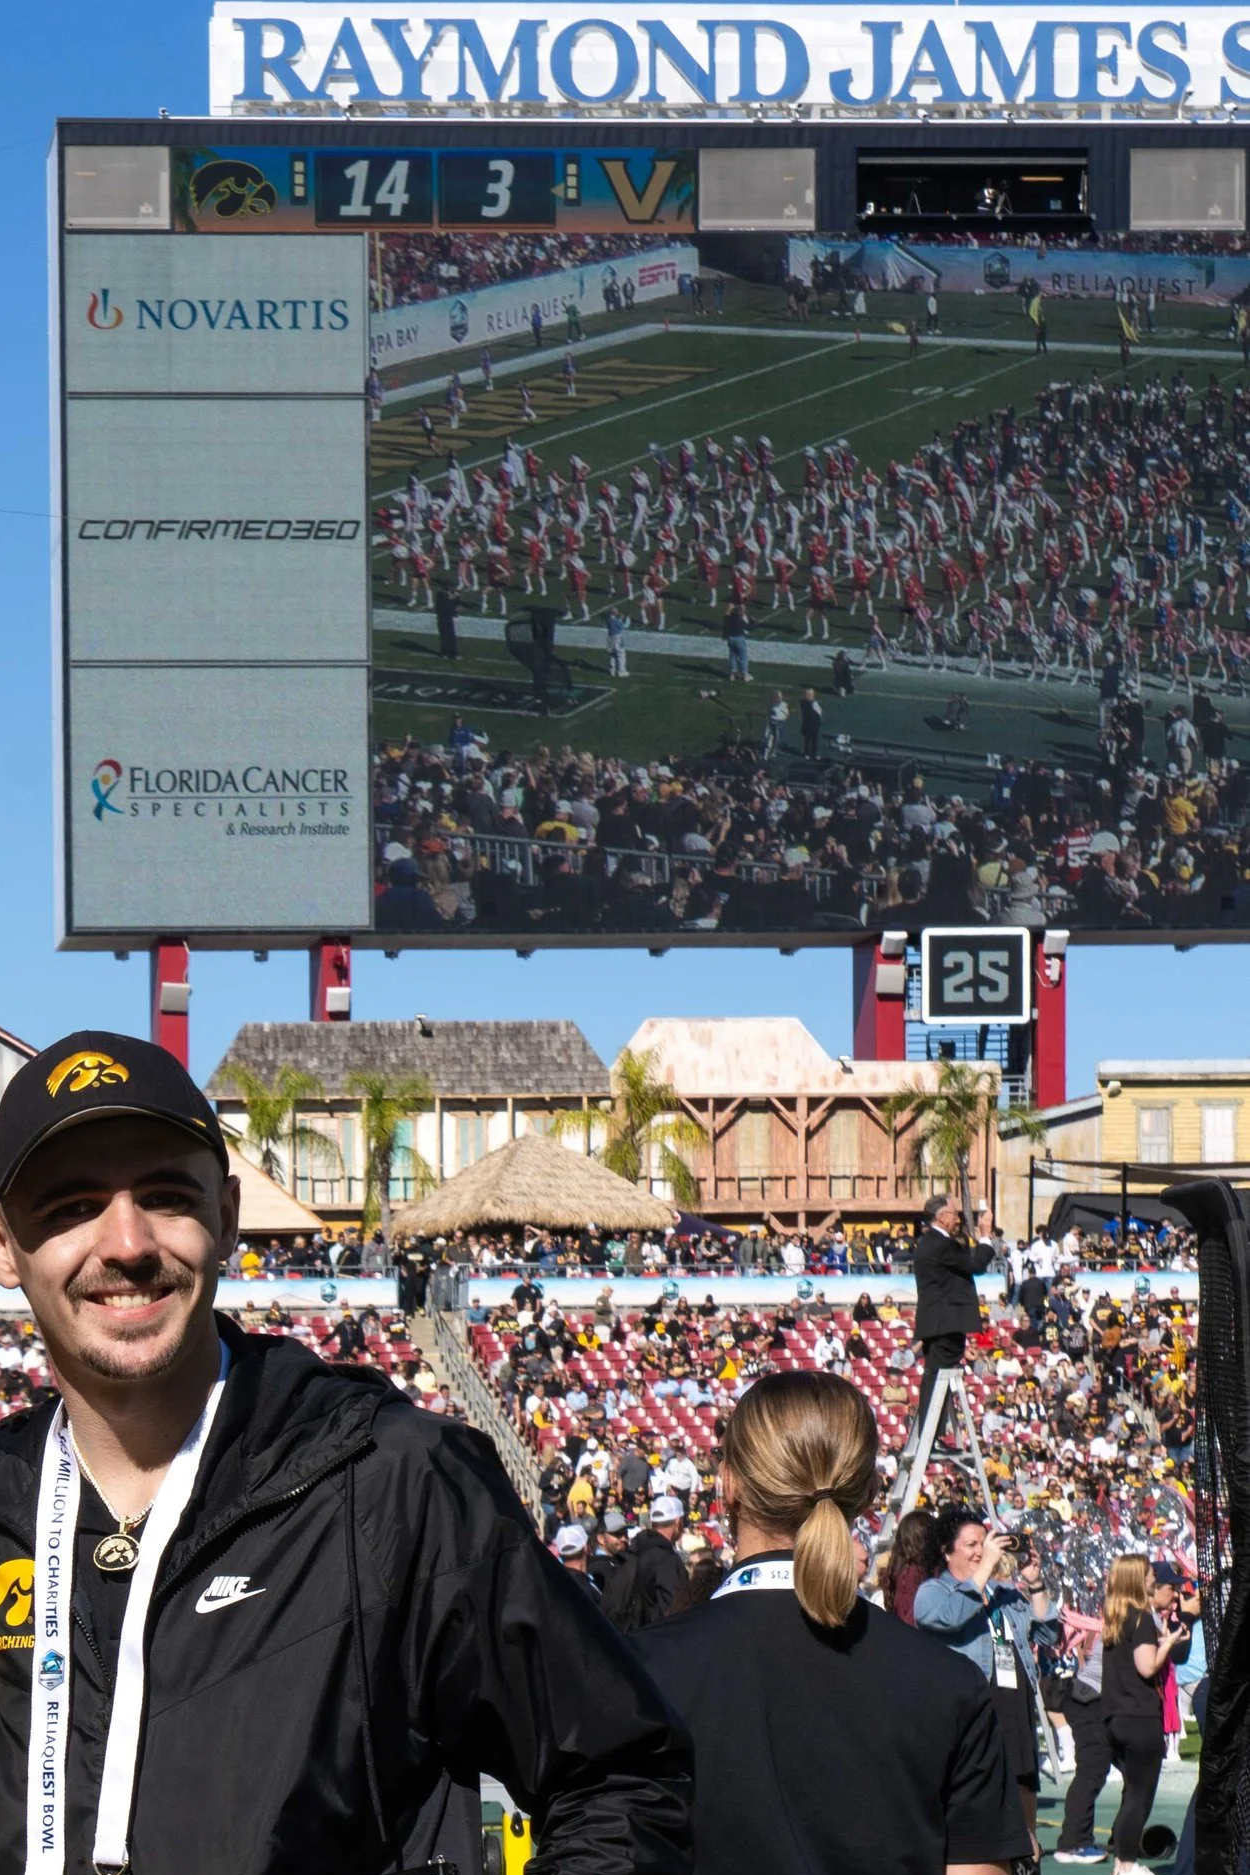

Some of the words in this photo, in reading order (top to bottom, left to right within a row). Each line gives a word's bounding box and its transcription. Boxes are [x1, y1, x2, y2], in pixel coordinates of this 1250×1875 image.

[232, 17, 810, 105] RAYMOND
[828, 18, 1192, 107] JAMES
[339, 158, 410, 218] 14
[480, 159, 515, 218] 3
[135, 298, 350, 331] NOVARTIS
[396, 324, 421, 348] BAY
[78, 518, 361, 541] CONFIRMED360
[129, 766, 239, 794] FLORIDA
[241, 766, 350, 794] CANCER
[130, 801, 350, 817] SPECIALISTS
[225, 823, 237, 837] &
[239, 822, 296, 837] Research
[299, 822, 350, 837] Institute
[942, 950, 1010, 1003] 25
[51, 1458, 71, 1524] MILLION
[48, 1528, 62, 1550] TO
[45, 1554, 61, 1638] CHARITIES
[204, 1575, 251, 1597] NIKE
[41, 1701, 59, 1798] RELIAQUEST
[42, 1804, 55, 1854] BOWL
